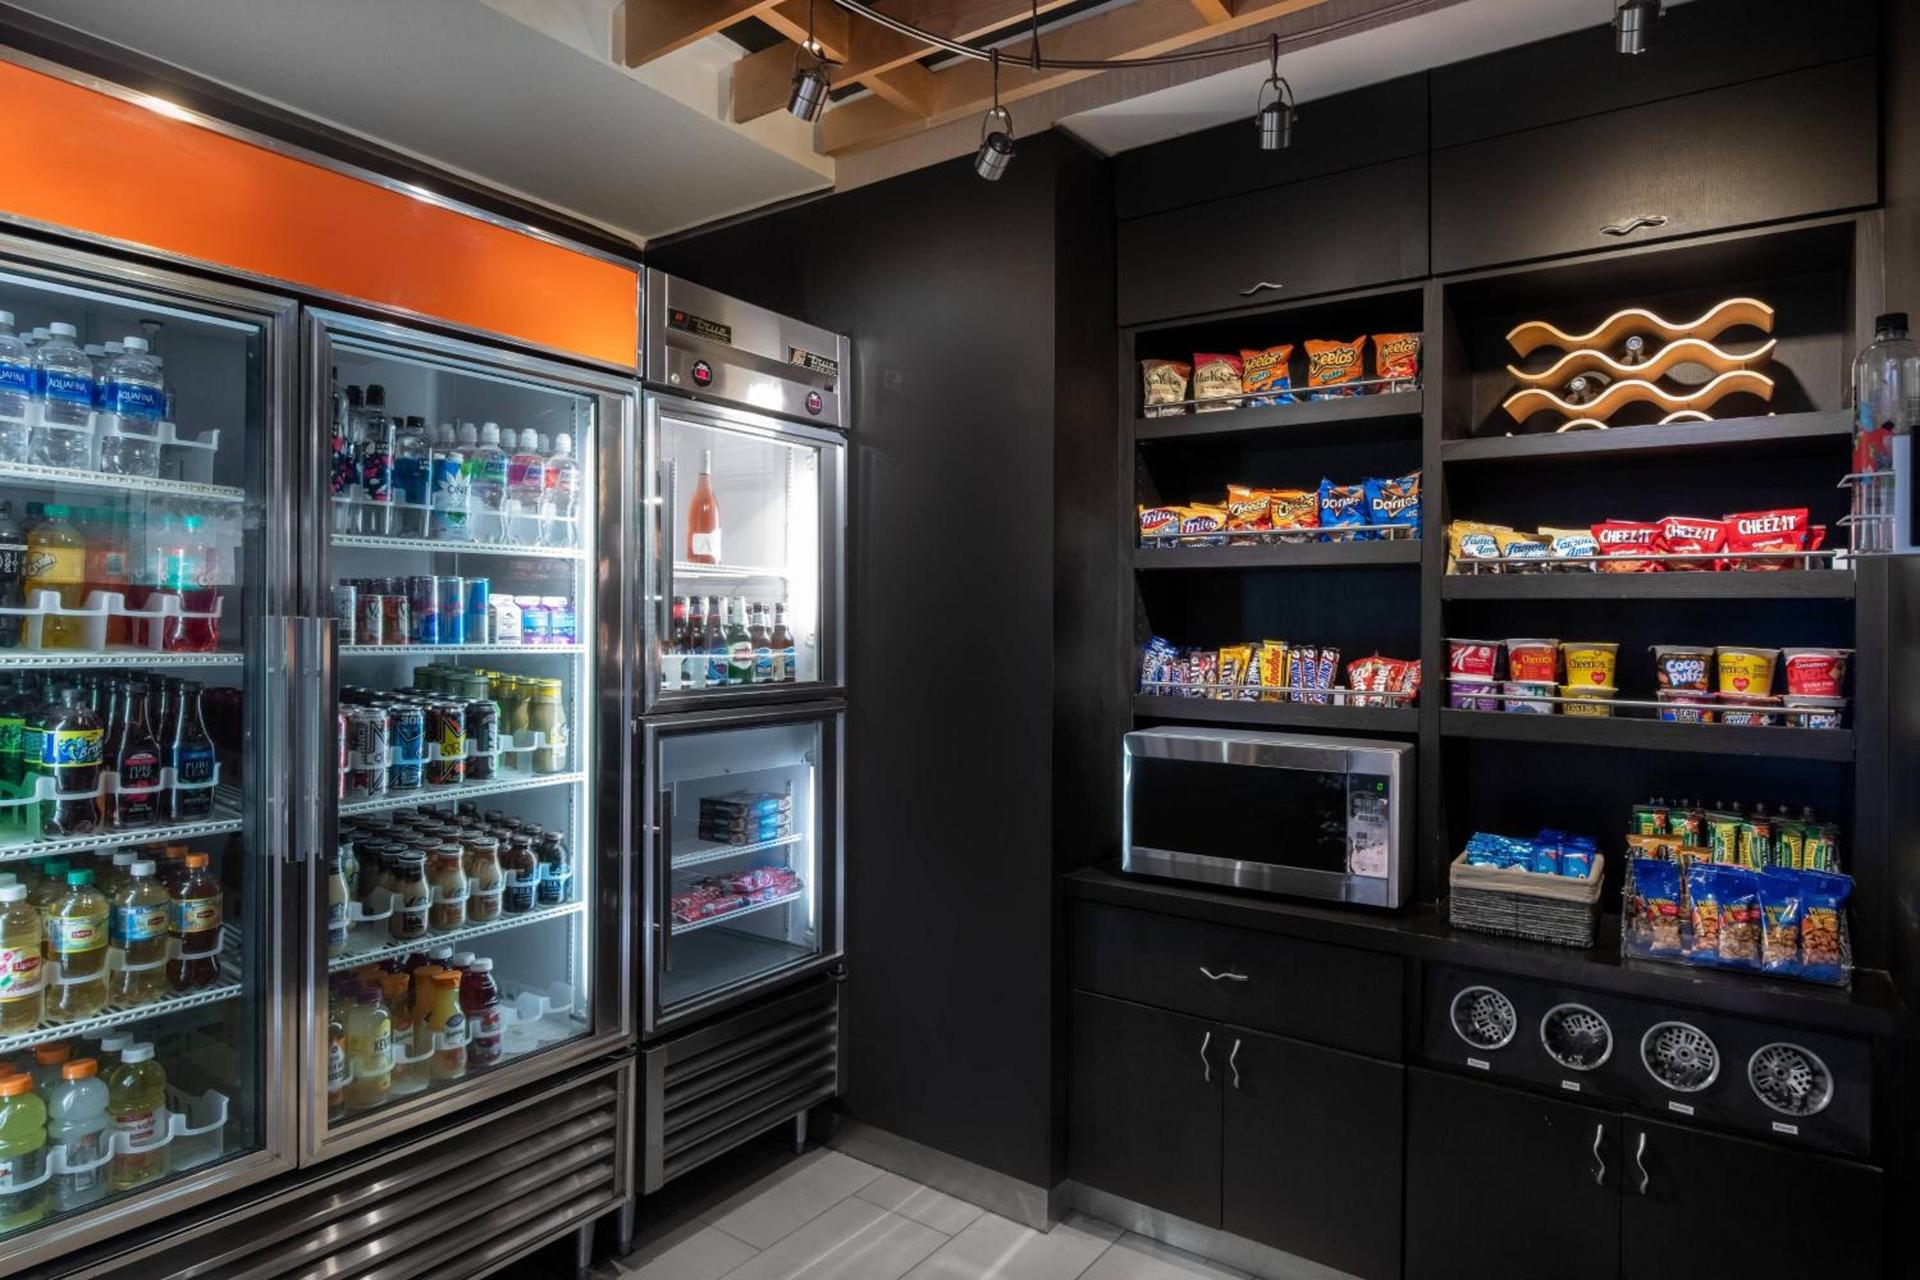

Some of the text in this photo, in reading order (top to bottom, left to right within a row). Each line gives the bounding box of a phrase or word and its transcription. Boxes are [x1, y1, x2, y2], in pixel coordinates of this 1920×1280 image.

[48, 379, 87, 395] AQUAFINA
[118, 391, 153, 405] AQUAFINA
[1373, 494, 1419, 511] Doritos
[1665, 659, 1705, 673] Cocoa
